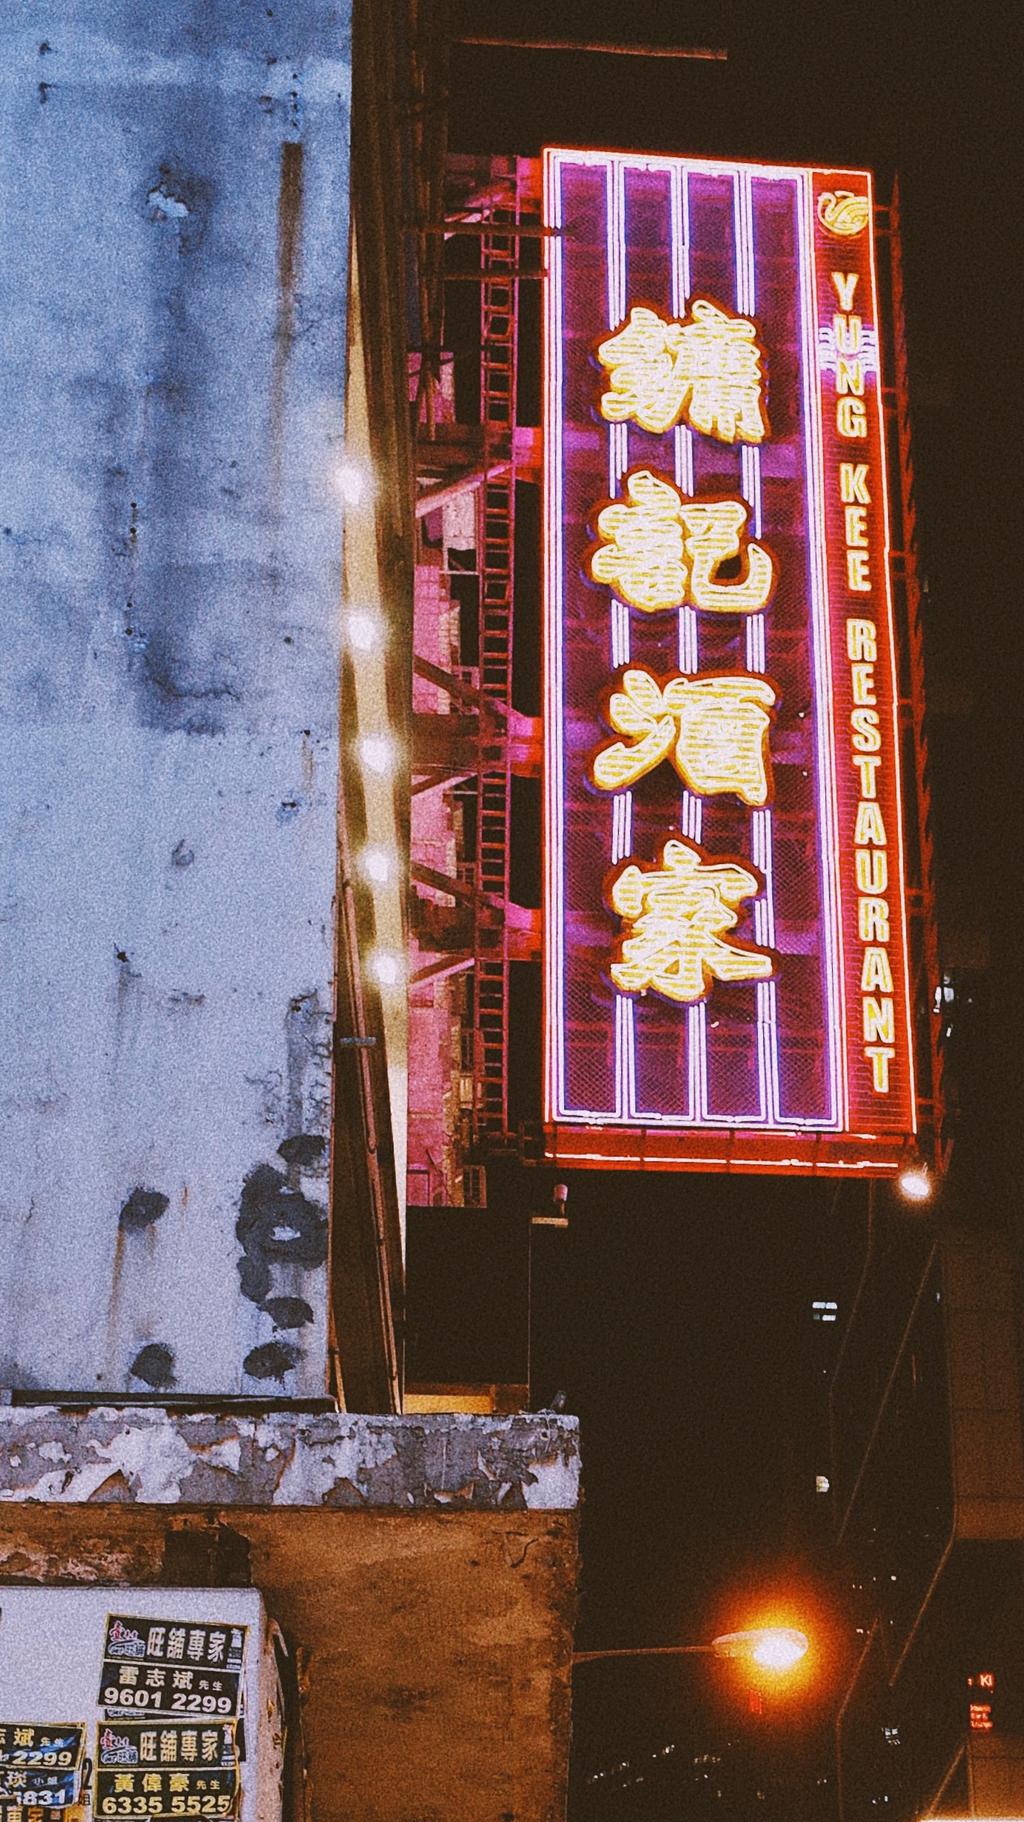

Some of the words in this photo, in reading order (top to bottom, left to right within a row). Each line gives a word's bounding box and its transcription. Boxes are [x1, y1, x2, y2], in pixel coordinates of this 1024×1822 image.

[832, 270, 869, 437] YUNG
[839, 462, 872, 594] KEE
[592, 300, 775, 1002] 鏞記酒家
[847, 618, 896, 1094] RESTAURANT
[12, 1750, 73, 1766] 2299
[104, 1687, 163, 1708] 9601
[170, 1693, 232, 1714] 2299
[101, 1796, 163, 1814] 6335
[171, 1795, 231, 1814] 5525
